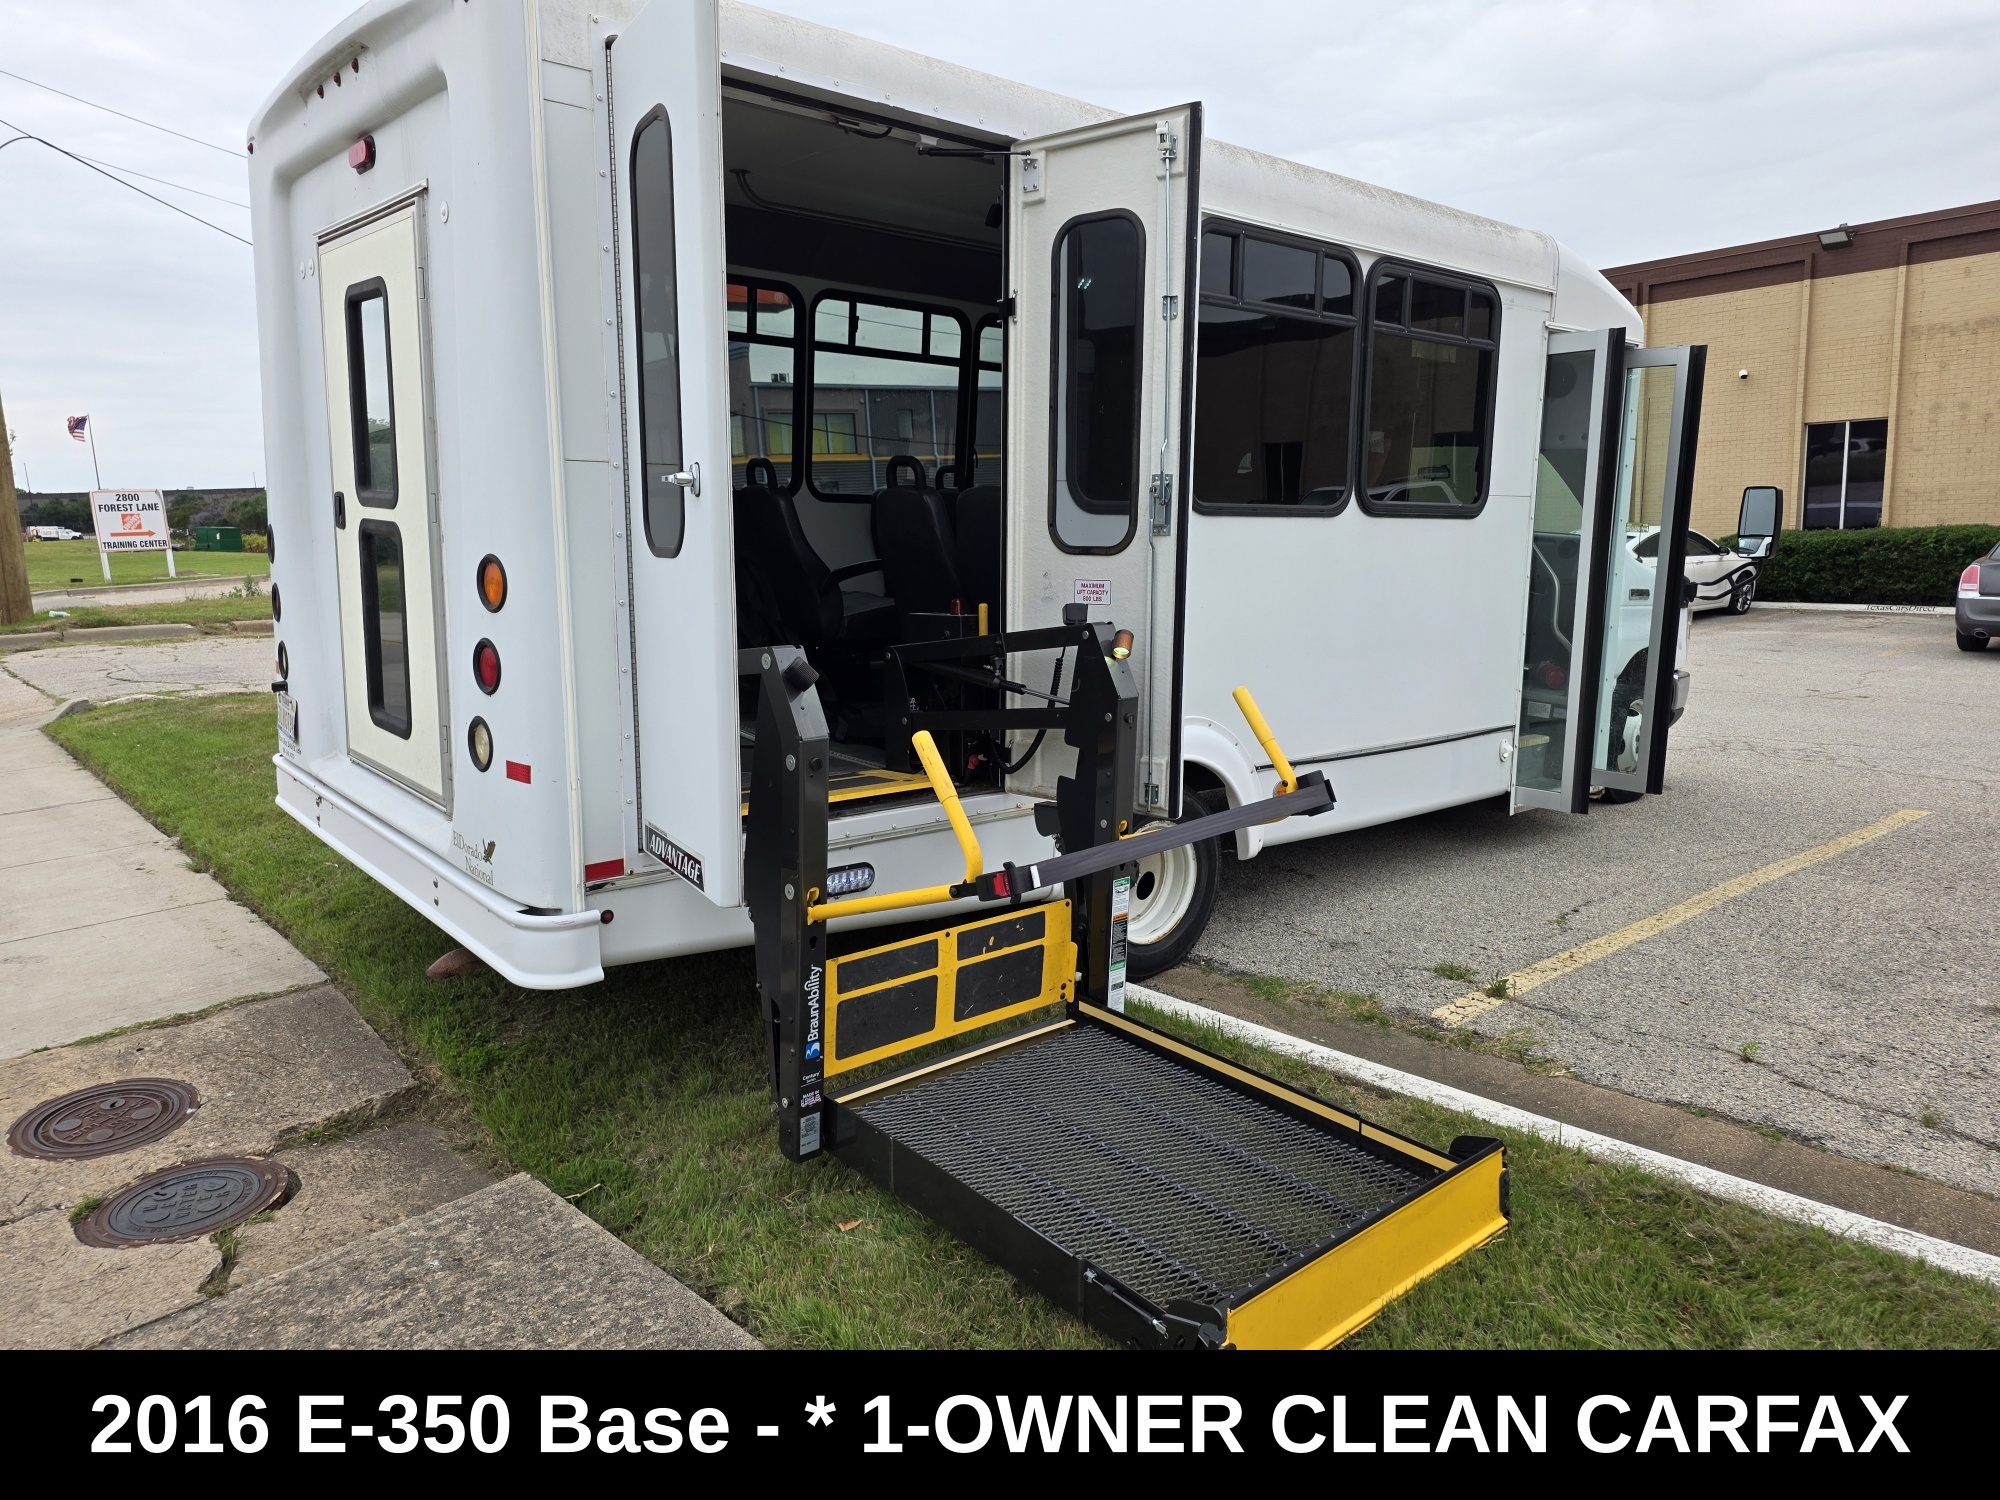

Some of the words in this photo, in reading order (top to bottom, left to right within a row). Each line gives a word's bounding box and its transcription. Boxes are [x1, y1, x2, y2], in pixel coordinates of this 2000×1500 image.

[98, 504, 133, 512] FOREST
[136, 503, 160, 511] LANE
[116, 493, 140, 502] 2800
[103, 541, 137, 549] TRAINING
[140, 540, 167, 548] CENTER
[453, 830, 483, 861] ElDorado
[650, 833, 701, 884] ADVANTAGE
[465, 855, 494, 886] National
[804, 966, 823, 1042] BraunAbility
